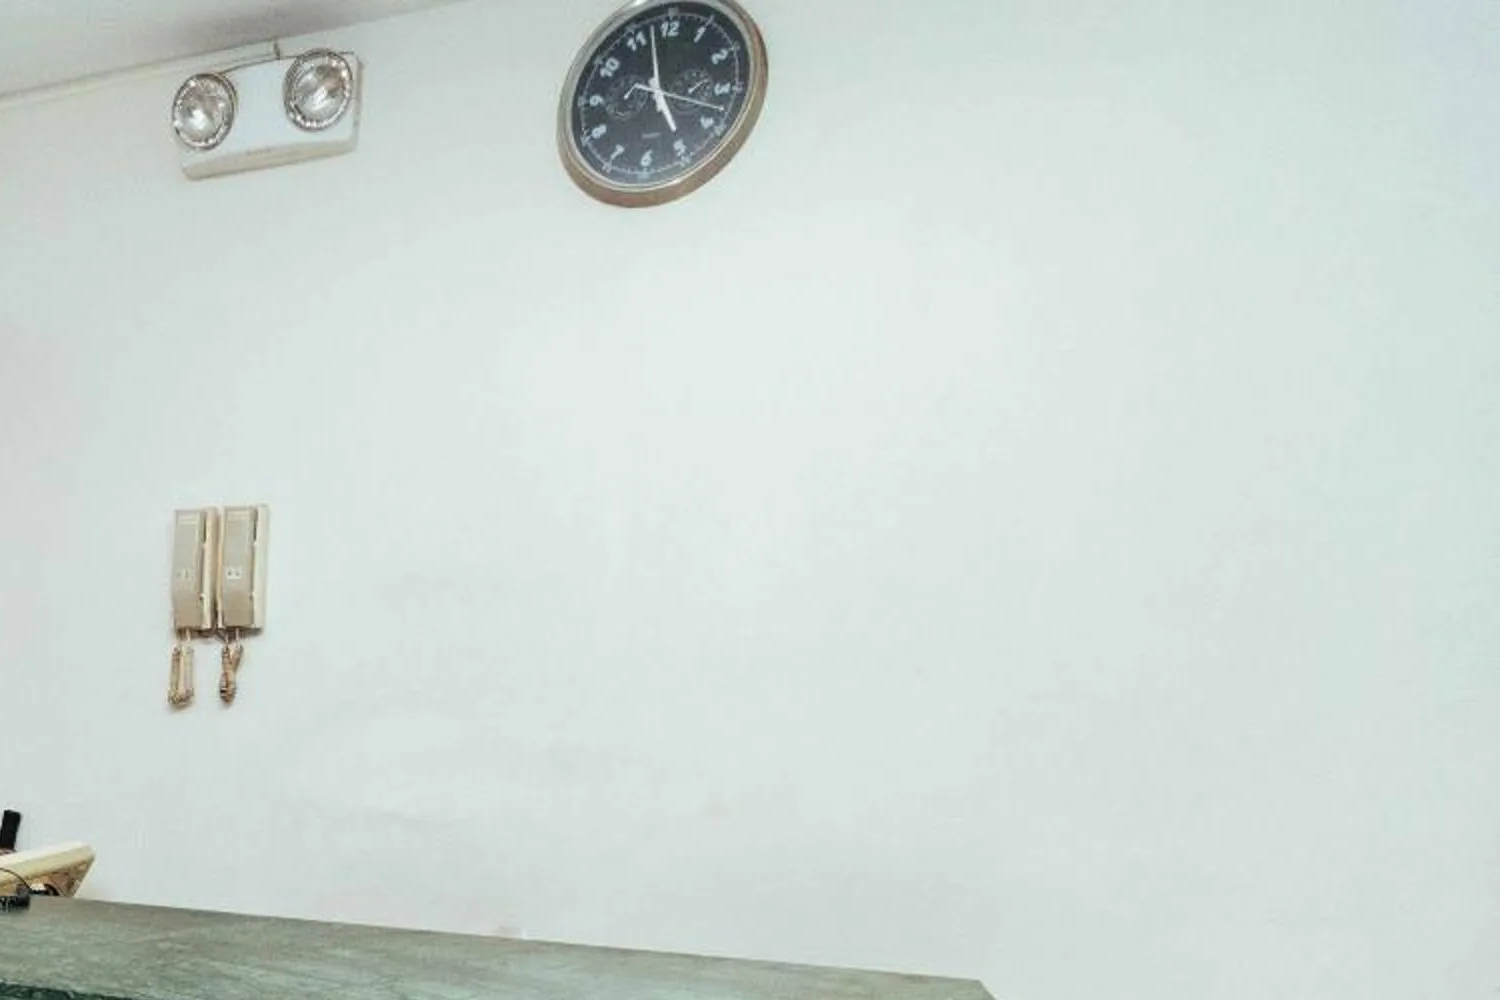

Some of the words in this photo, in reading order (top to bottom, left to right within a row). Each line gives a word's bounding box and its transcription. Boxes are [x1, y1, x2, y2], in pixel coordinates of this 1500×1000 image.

[660, 20, 680, 38] 12
[693, 26, 707, 43] 1
[626, 31, 647, 51] 11
[711, 49, 730, 65] 2
[600, 57, 621, 77] 10
[591, 124, 607, 139] 8
[610, 144, 625, 161] 7
[640, 150, 653, 167] 6
